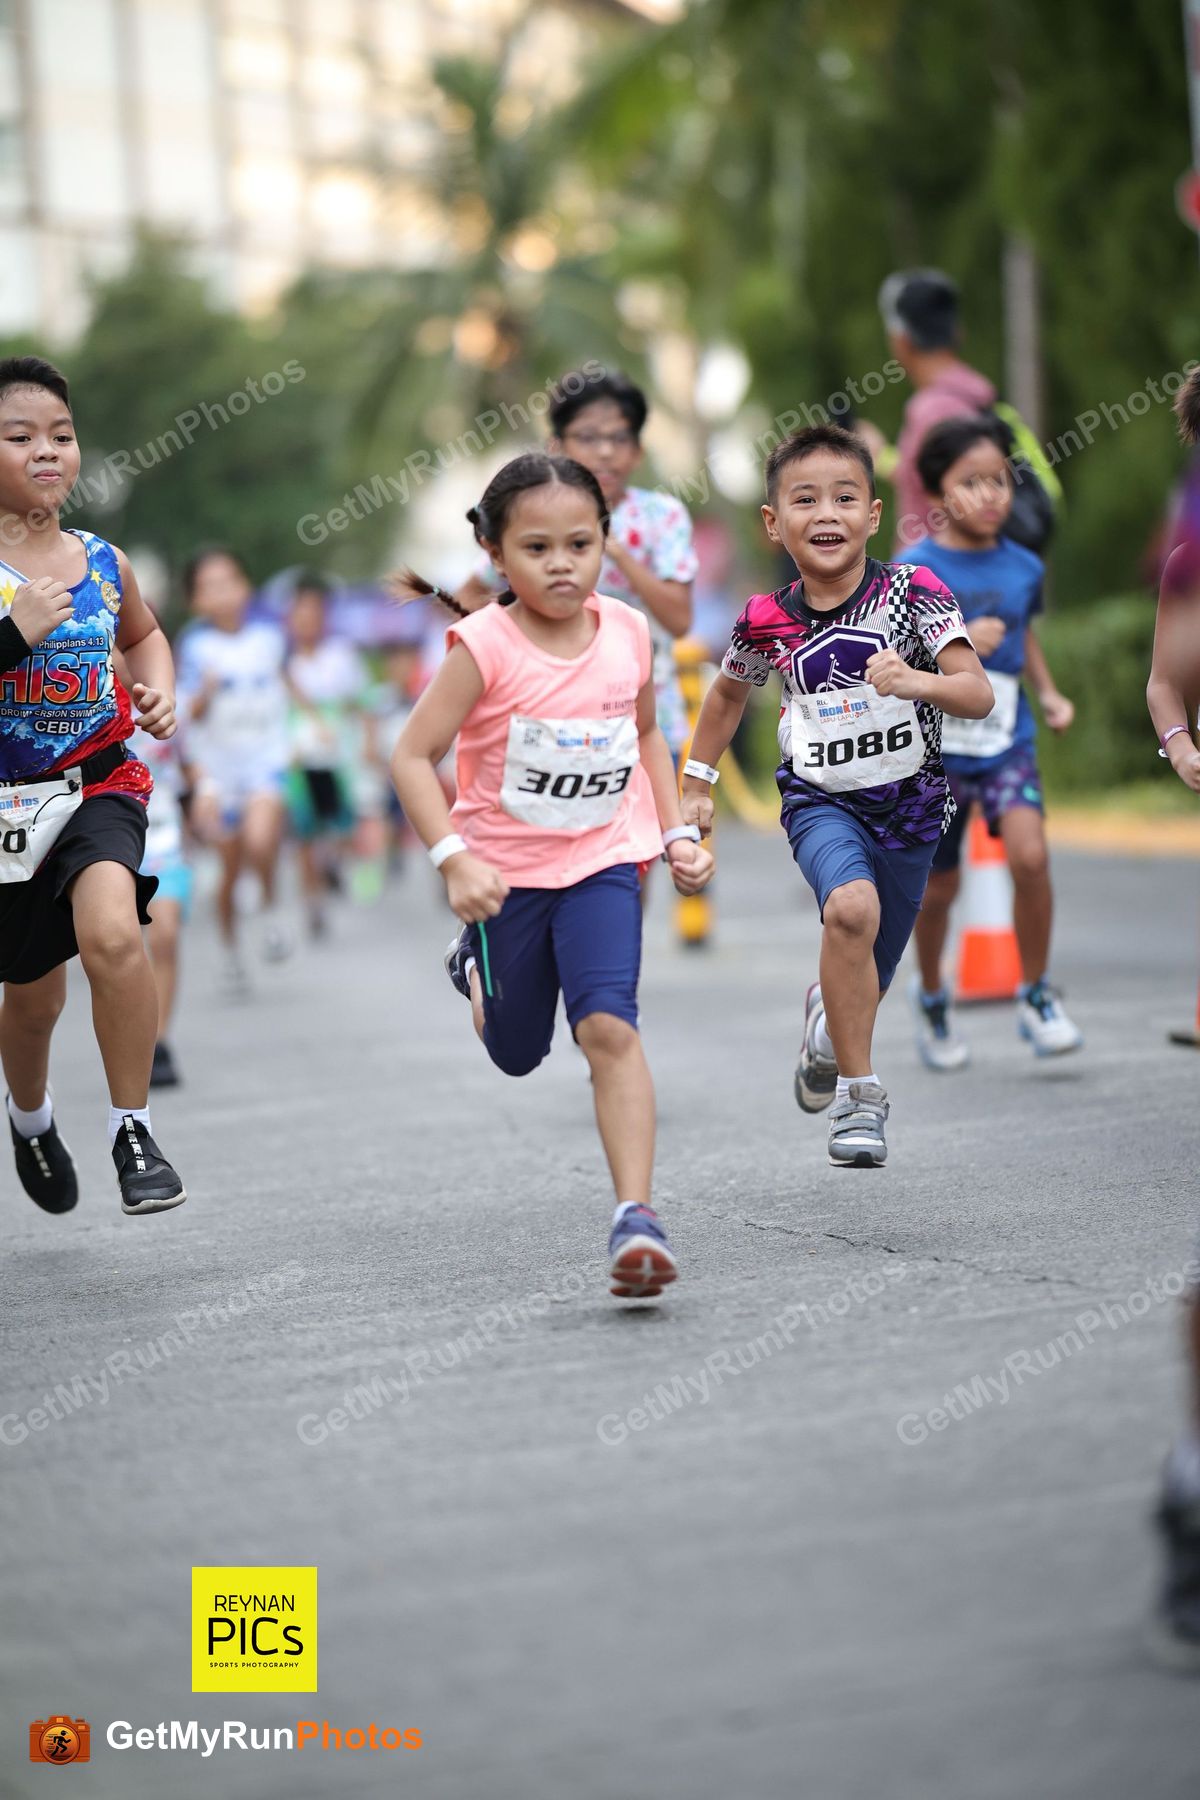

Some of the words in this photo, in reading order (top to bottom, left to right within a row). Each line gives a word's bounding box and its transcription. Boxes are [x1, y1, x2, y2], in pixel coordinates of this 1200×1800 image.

[923, 617, 955, 643] TEAM
[819, 700, 869, 717] IRONKIDS
[35, 720, 82, 735] CEBU
[804, 720, 912, 767] 3086
[518, 766, 632, 799] 3053
